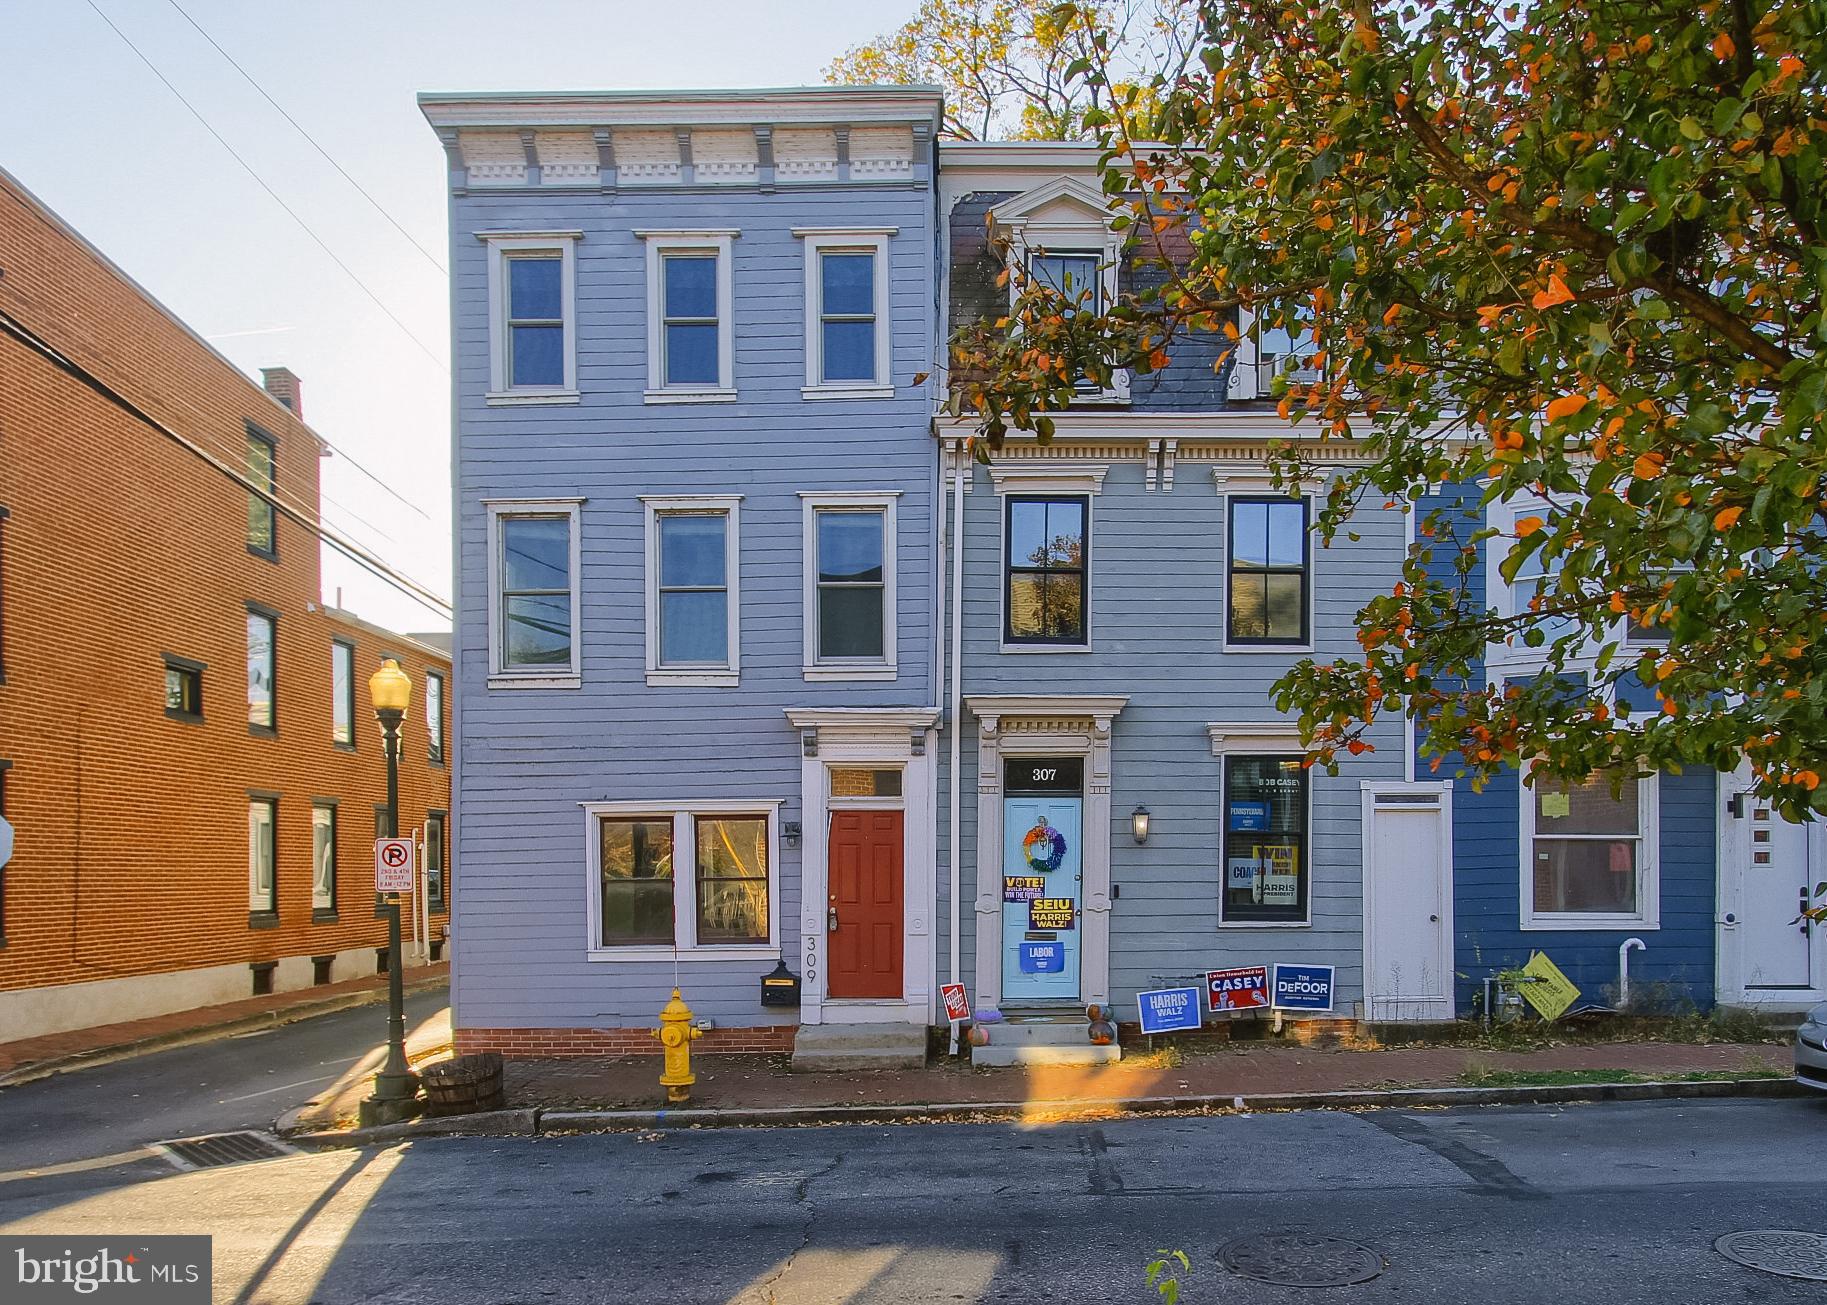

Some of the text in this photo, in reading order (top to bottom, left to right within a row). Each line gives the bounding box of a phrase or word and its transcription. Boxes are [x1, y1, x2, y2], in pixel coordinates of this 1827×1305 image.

[1032, 768, 1057, 781] 307
[1005, 877, 1044, 888] VOTE!
[1256, 883, 1295, 892] HARRIS
[1033, 899, 1070, 910] SEIU
[1031, 913, 1072, 921] HARRIS
[1036, 920, 1067, 928] WALZ!
[1029, 946, 1055, 958] LABOR
[1211, 975, 1263, 992] CASEY
[1150, 993, 1188, 1010] HARRIS
[1156, 1006, 1183, 1017] WALZ
